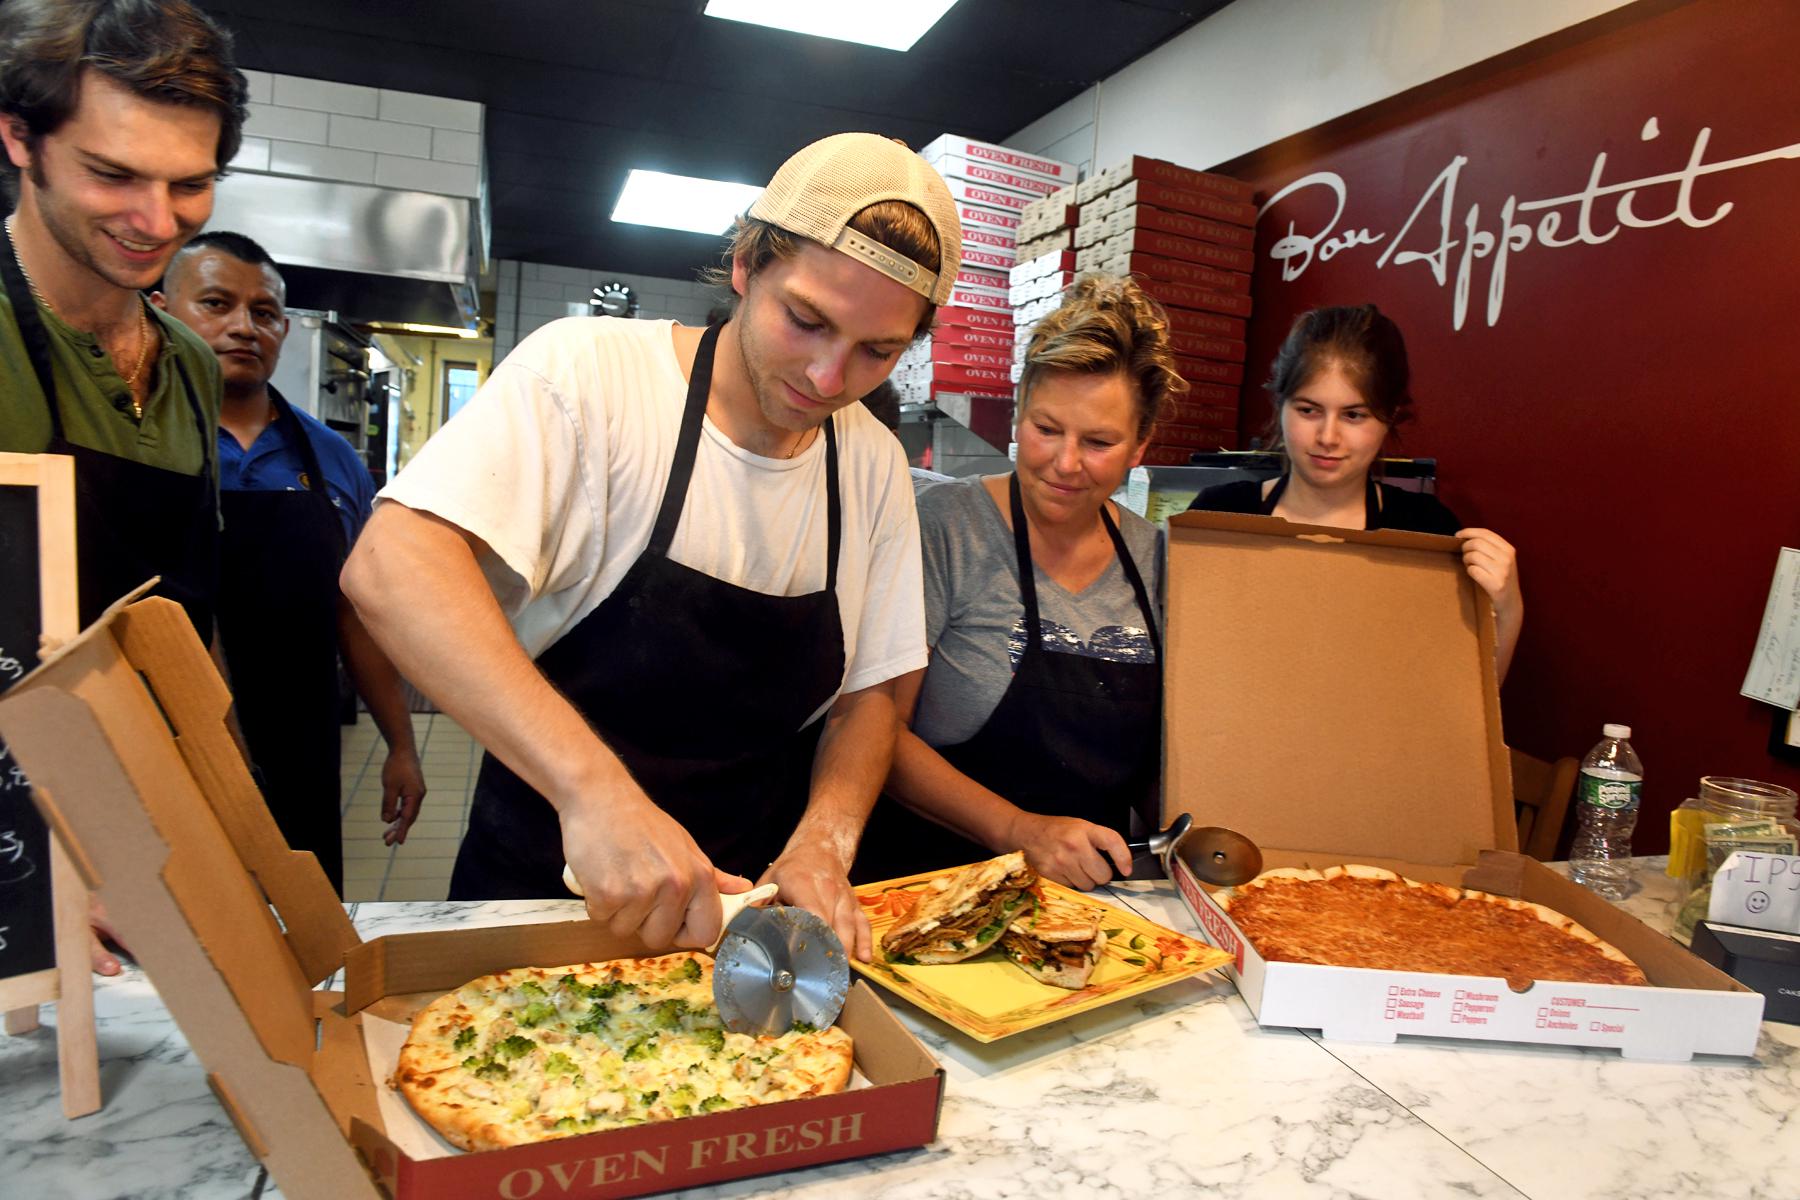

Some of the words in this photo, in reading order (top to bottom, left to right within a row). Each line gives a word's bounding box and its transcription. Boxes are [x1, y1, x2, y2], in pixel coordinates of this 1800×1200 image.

[971, 146, 1009, 162] OVEN
[1011, 157, 1055, 174] FRESH
[972, 168, 1009, 183] OVEN
[1012, 177, 1055, 193] FRESH
[970, 189, 1007, 205] OVEN
[968, 210, 1004, 226] OVEN
[1257, 172, 1386, 282] Bon
[1376, 117, 1800, 331] Appetit
[967, 232, 1002, 247] OVEN
[965, 252, 1000, 266] OVEN
[963, 274, 998, 286] OVEN
[961, 293, 996, 306] OVEN
[966, 314, 998, 326] OVEN
[964, 334, 995, 344] OVEN
[964, 353, 995, 364] OVEN
[966, 369, 997, 379] OVEN
[498, 1146, 671, 1200] OVEN
[687, 1112, 866, 1170] FRESH
